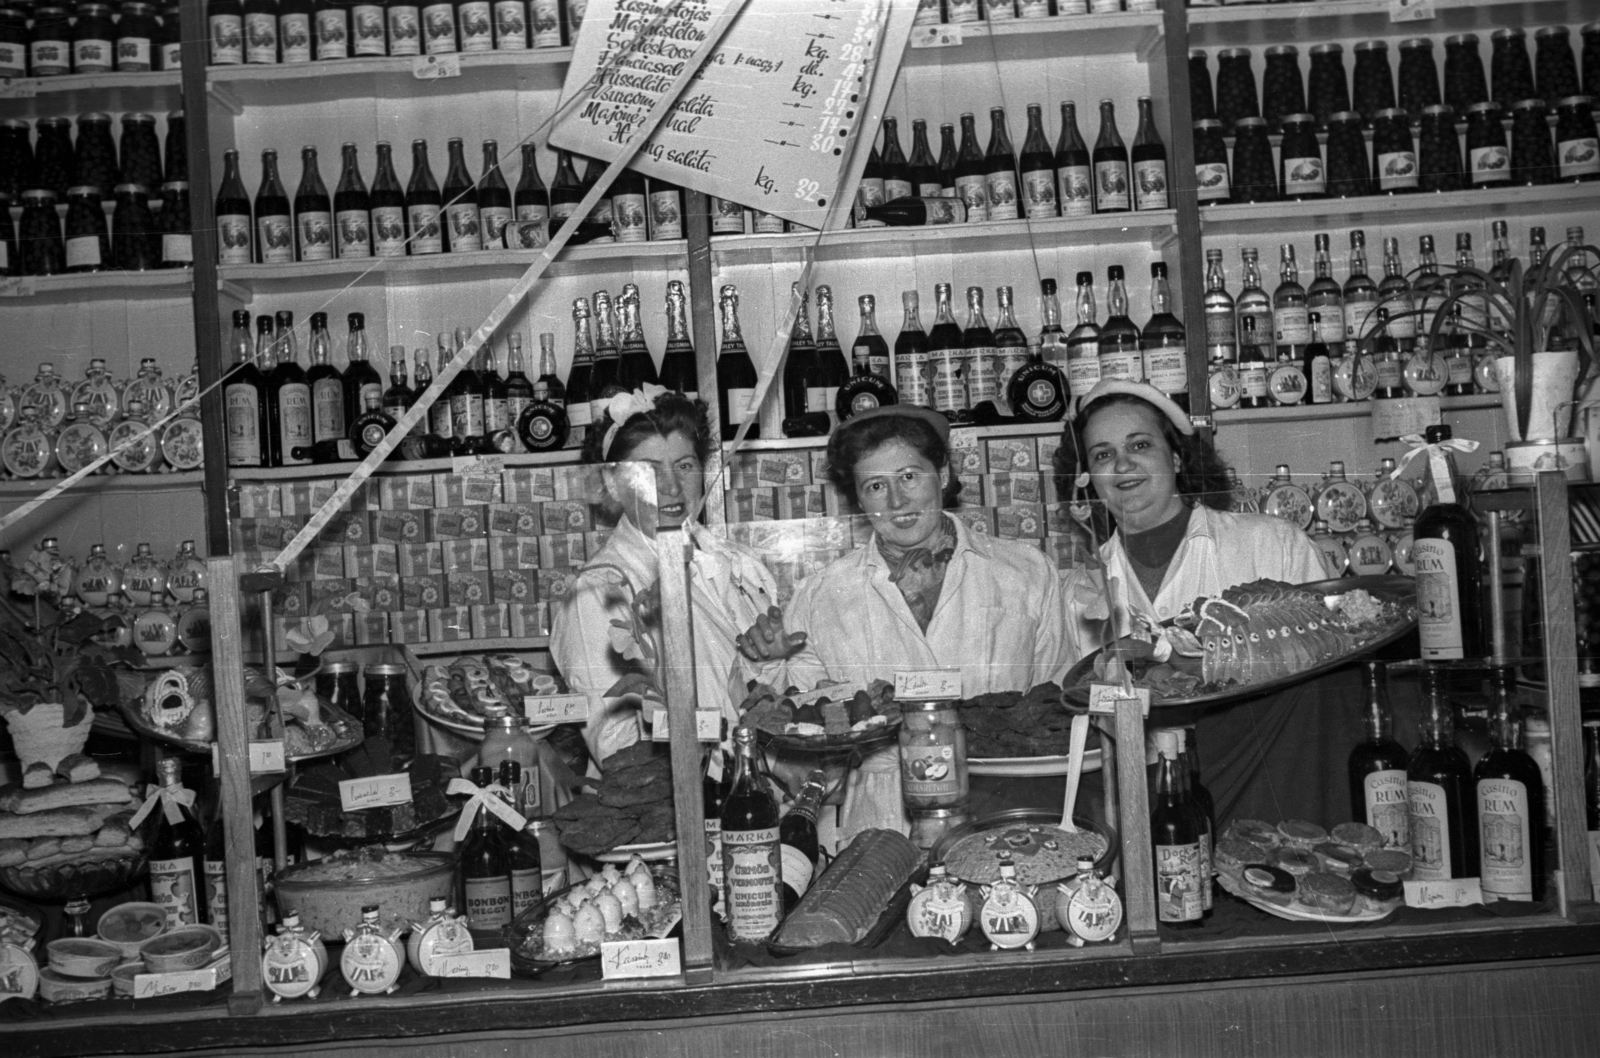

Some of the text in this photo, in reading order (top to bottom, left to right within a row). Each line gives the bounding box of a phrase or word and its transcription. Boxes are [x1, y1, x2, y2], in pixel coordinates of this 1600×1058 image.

[666, 112, 702, 133] hal
[667, 150, 717, 172] saláta
[755, 165, 778, 195] kg.
[1018, 365, 1057, 382] UNICUM
[844, 376, 884, 391] UNICUM
[229, 397, 251, 406] RUM
[286, 397, 307, 406] RUM
[1370, 775, 1406, 789] Casino
[1375, 789, 1406, 803] RUM
[1481, 783, 1518, 798] Casino
[1484, 798, 1517, 813] RUM
[734, 890, 773, 900] UNICUM
